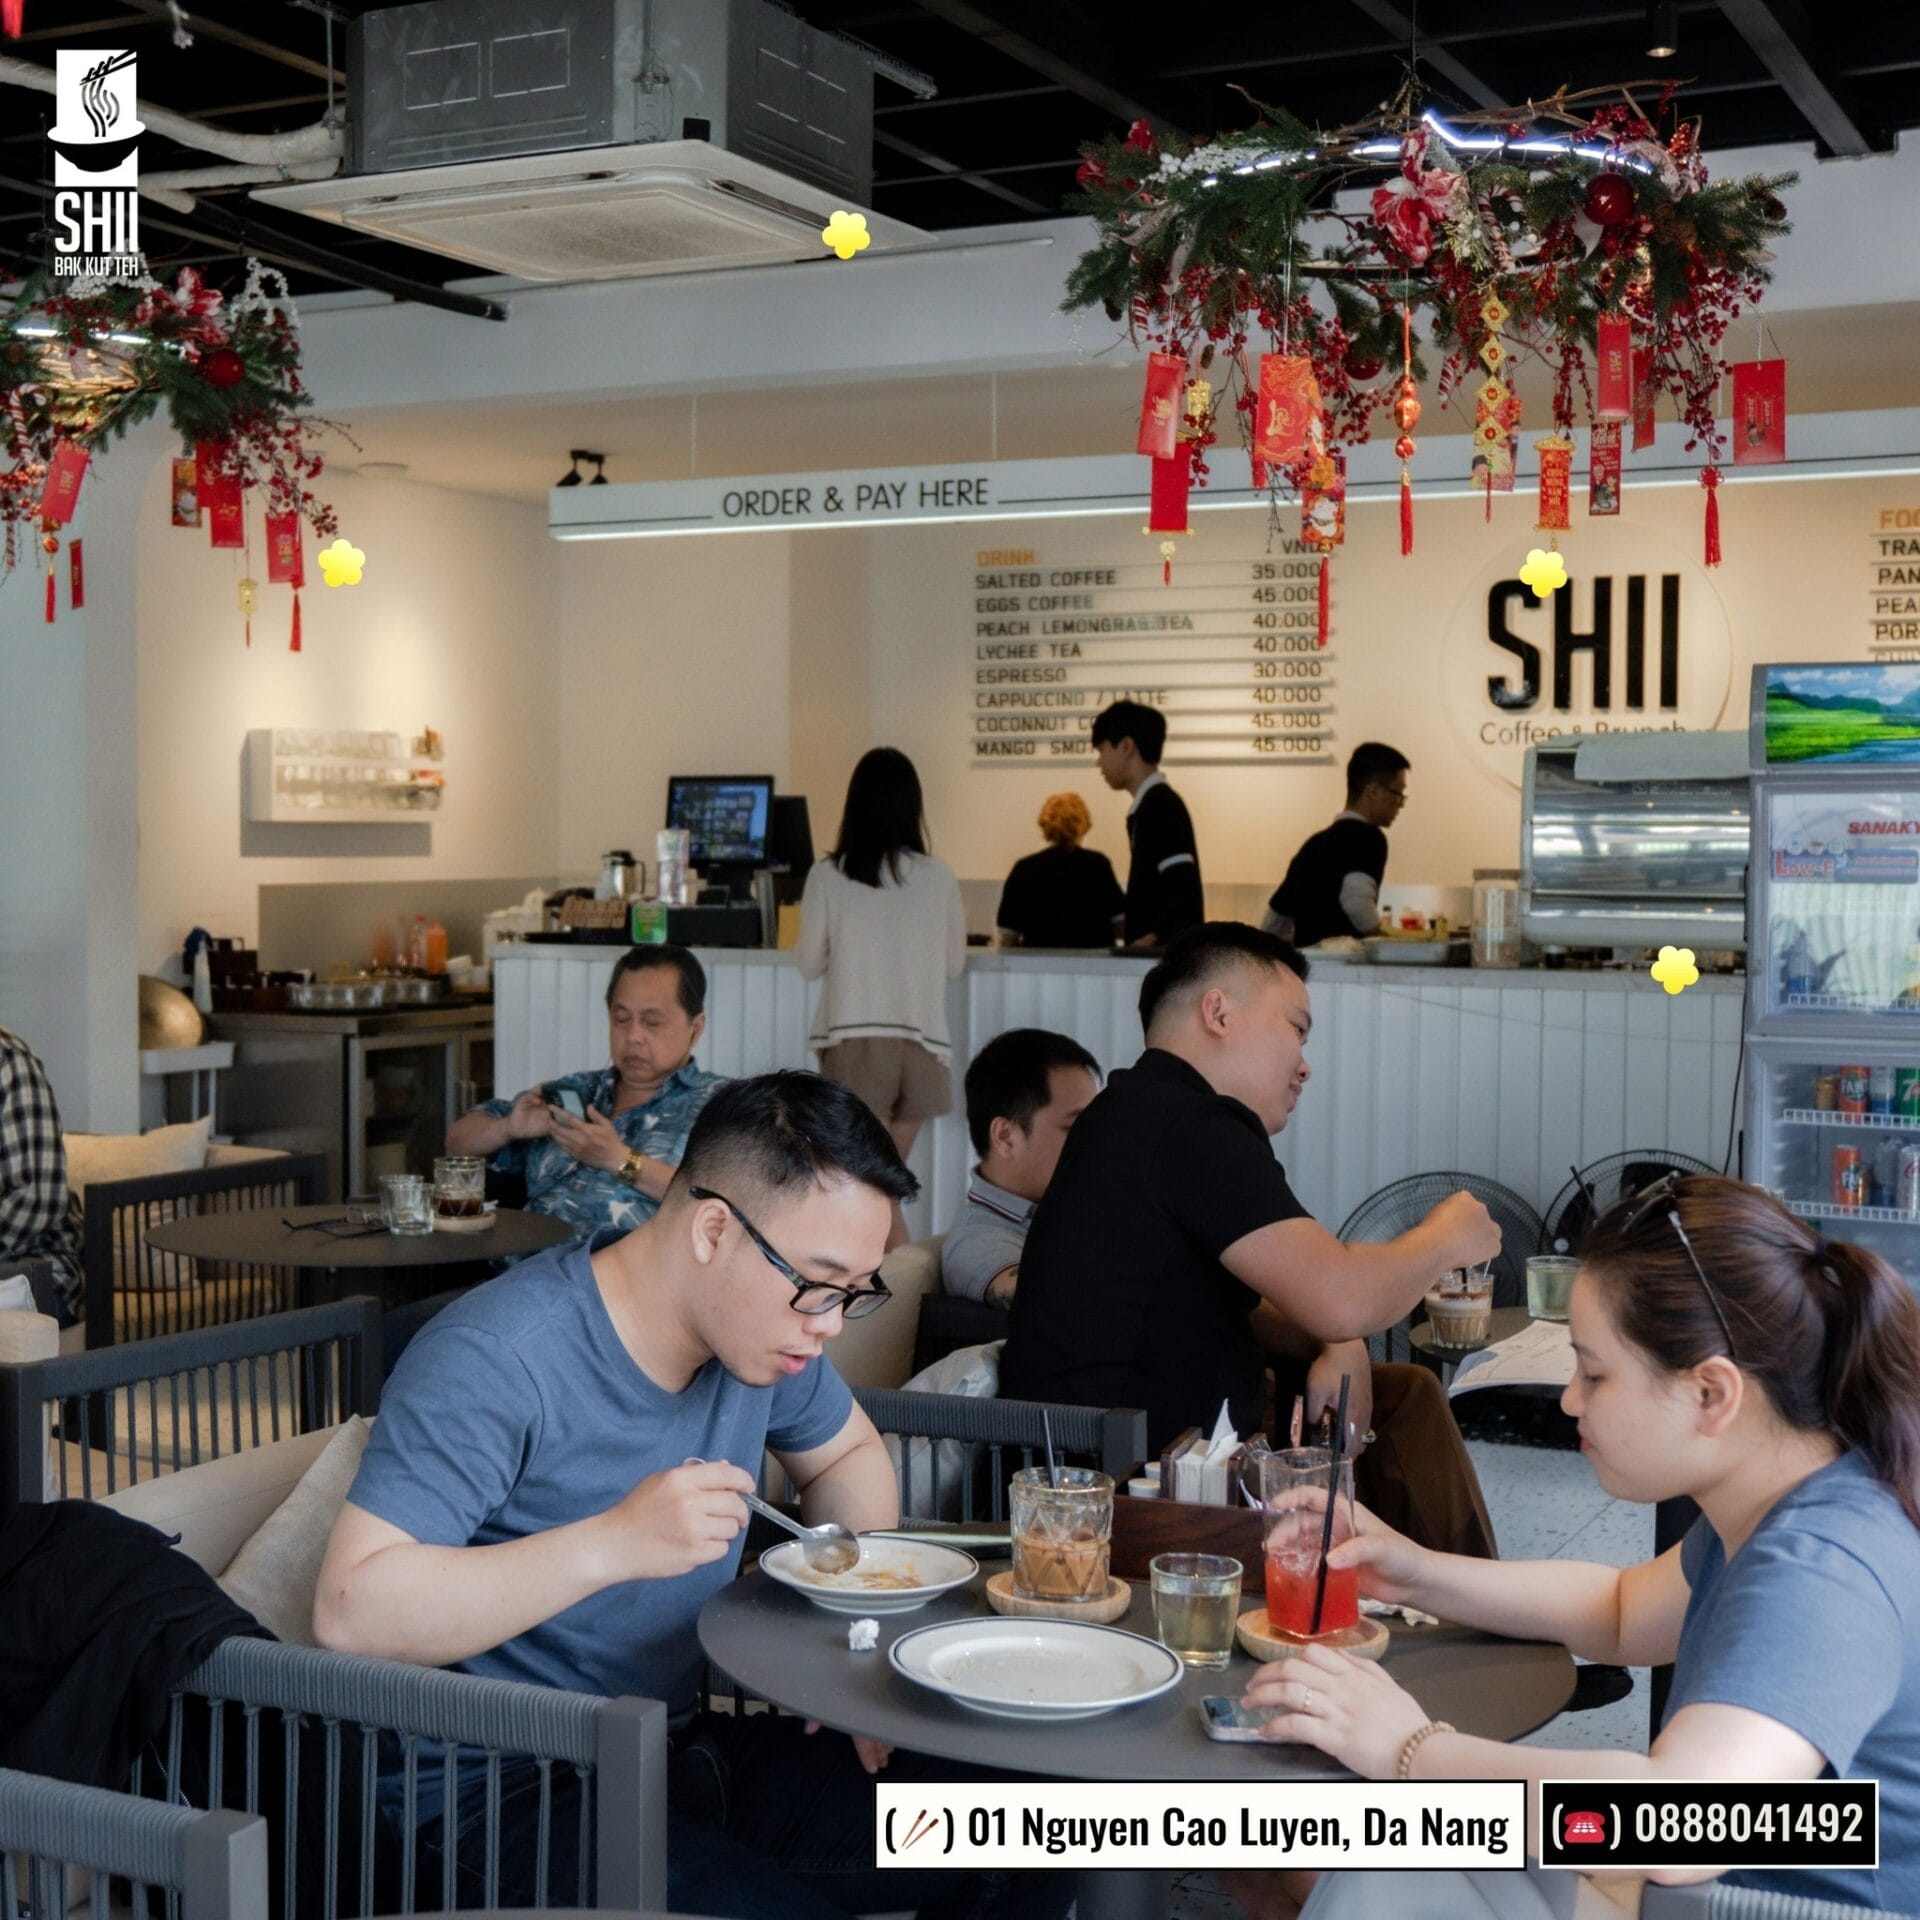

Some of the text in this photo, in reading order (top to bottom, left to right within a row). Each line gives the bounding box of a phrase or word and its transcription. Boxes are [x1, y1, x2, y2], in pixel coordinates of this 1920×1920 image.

[722, 477, 990, 518] ORDER & PAY HERE
[975, 562, 1321, 590] SALTED COFFEE 35.000
[976, 597, 1021, 613] EGGS
[1028, 594, 1094, 611] COFFEE
[1875, 597, 1920, 614] PEA
[976, 621, 1030, 637] PEACH
[976, 635, 1321, 660] LYCHEE TEA 40.000
[1487, 573, 1679, 711] SHII
[976, 660, 1322, 684] ESPRESSO 30.000
[975, 691, 1085, 708] CAPPUCCINO
[1252, 686, 1322, 703] 40.000
[976, 715, 1067, 732] COCONNUT
[1252, 711, 1321, 728] 45.000
[1479, 721, 1562, 746] Coffee
[976, 740, 1036, 756] MANGO
[1252, 735, 1321, 753] 45.000
